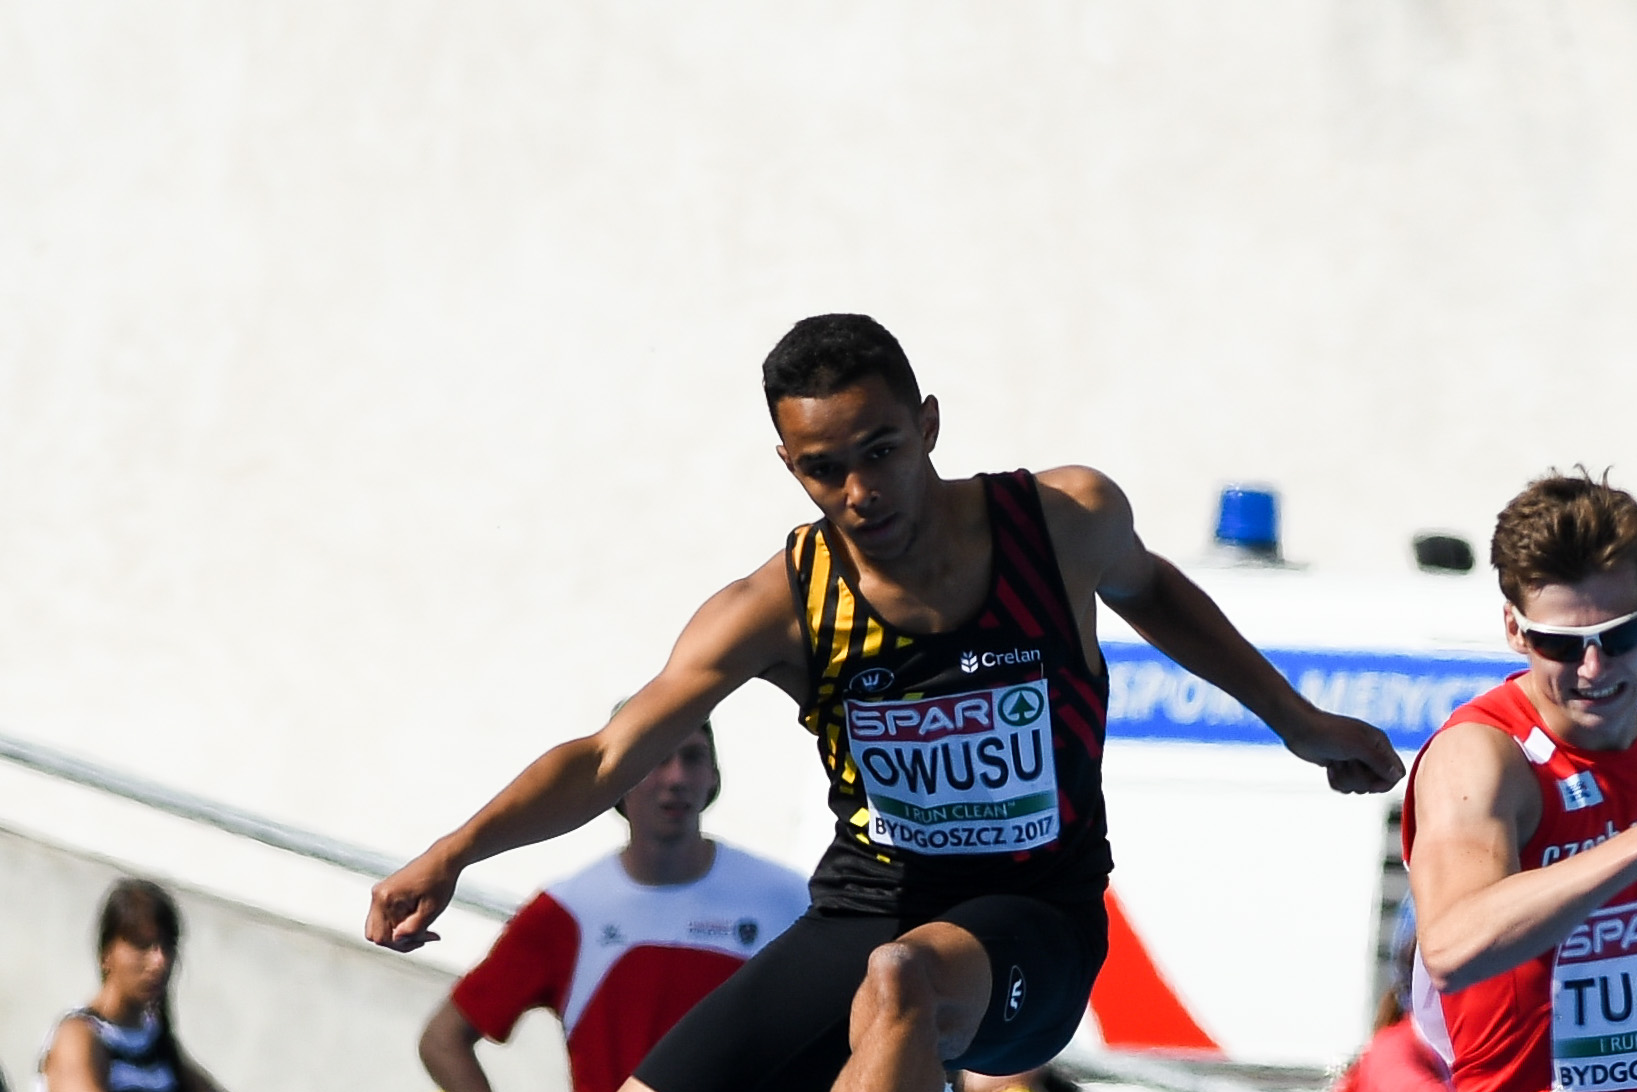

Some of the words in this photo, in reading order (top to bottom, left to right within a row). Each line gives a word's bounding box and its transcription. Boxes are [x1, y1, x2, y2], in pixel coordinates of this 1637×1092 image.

[982, 648, 1041, 667] Crelan
[851, 697, 990, 736] SPAR
[862, 729, 1043, 796] OWUSU
[875, 817, 1006, 848] BYDGOSZCZ
[1012, 816, 1054, 845] 2017
[912, 808, 947, 824] RUN
